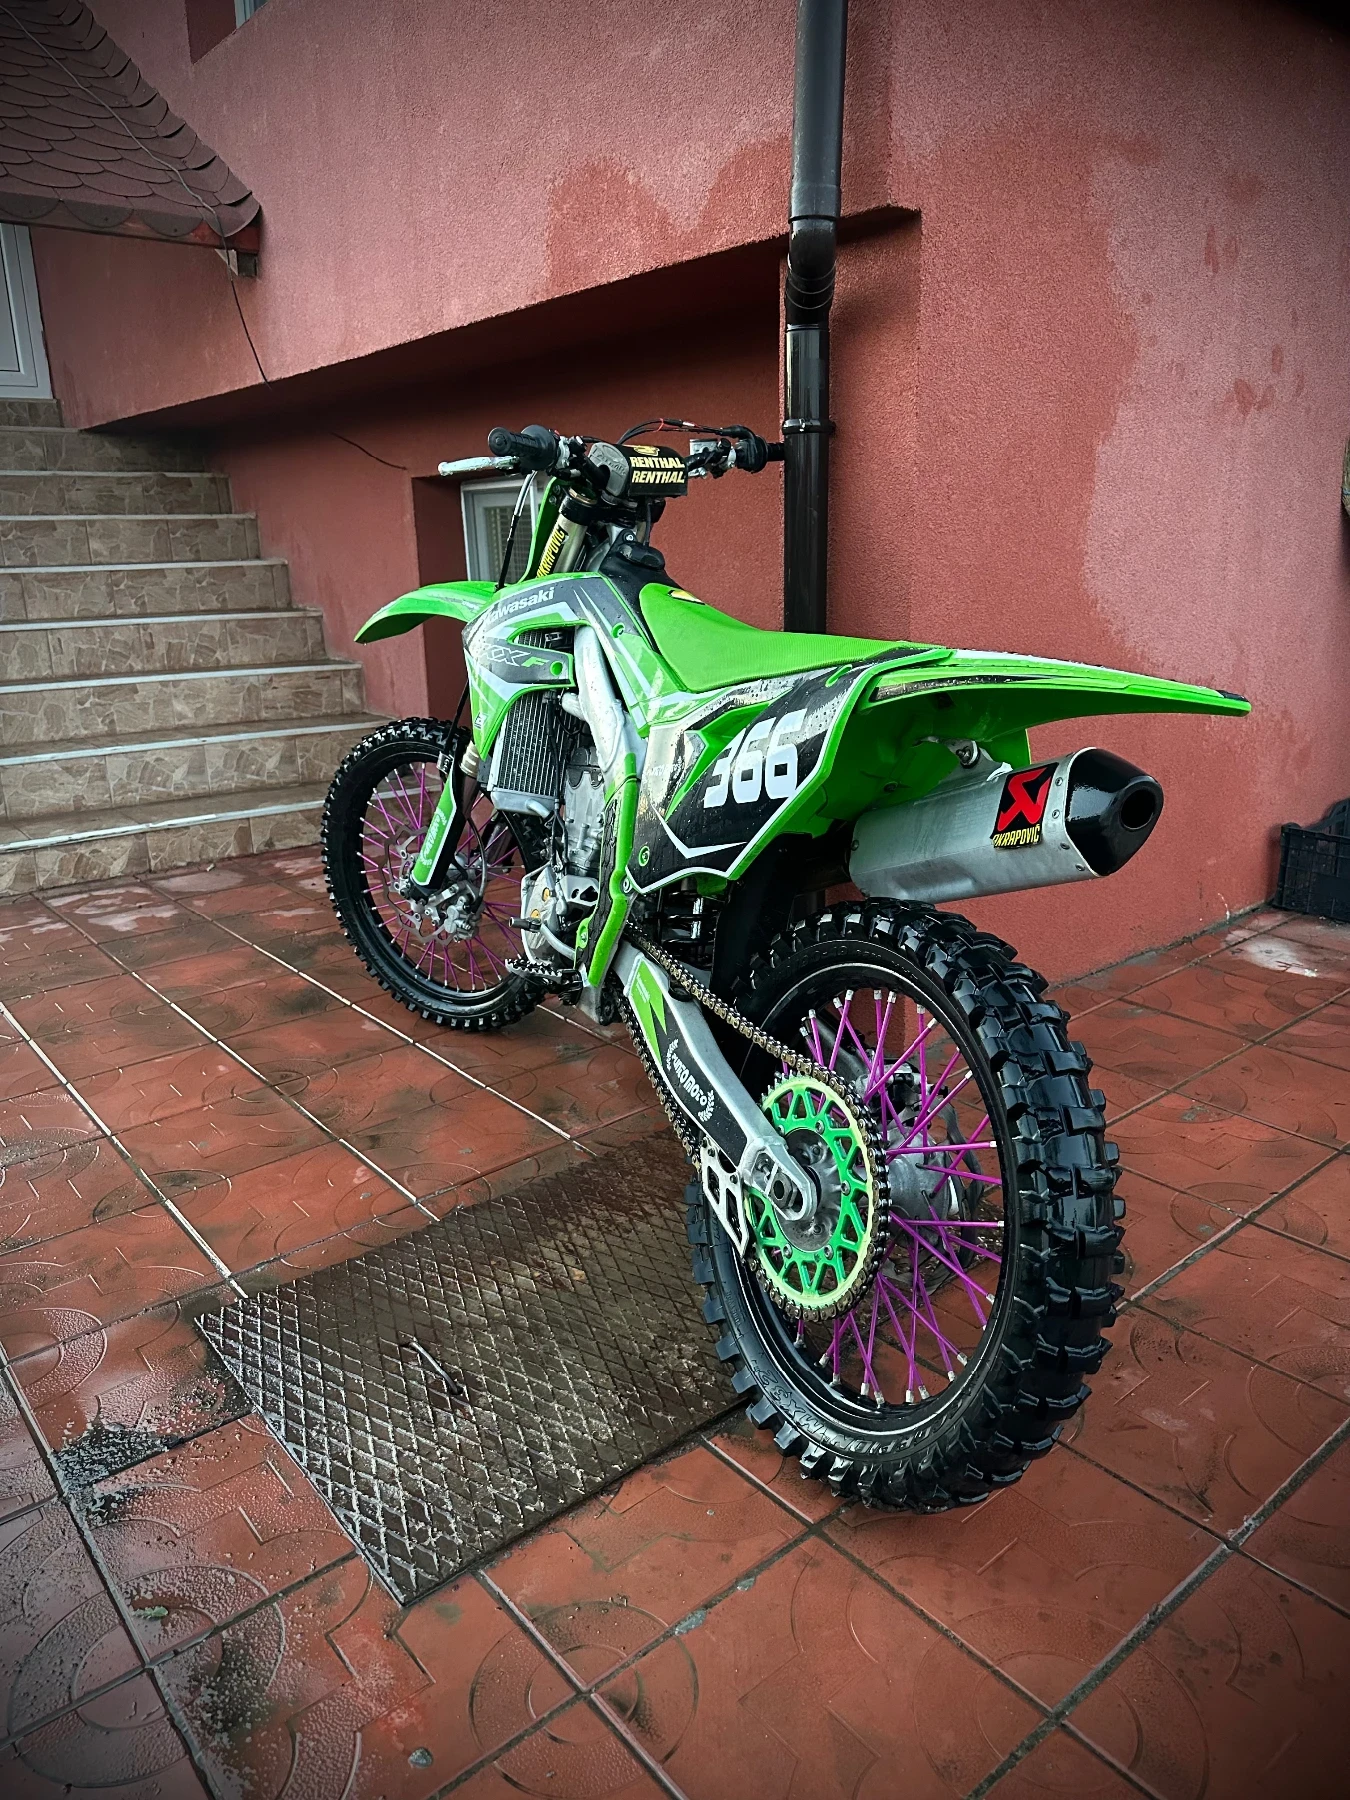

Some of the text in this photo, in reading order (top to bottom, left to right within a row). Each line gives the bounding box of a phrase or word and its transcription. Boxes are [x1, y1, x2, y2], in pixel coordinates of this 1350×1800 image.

[629, 456, 685, 469] RENTHAL
[631, 470, 685, 484] RENTHAL
[703, 708, 808, 808] 366
